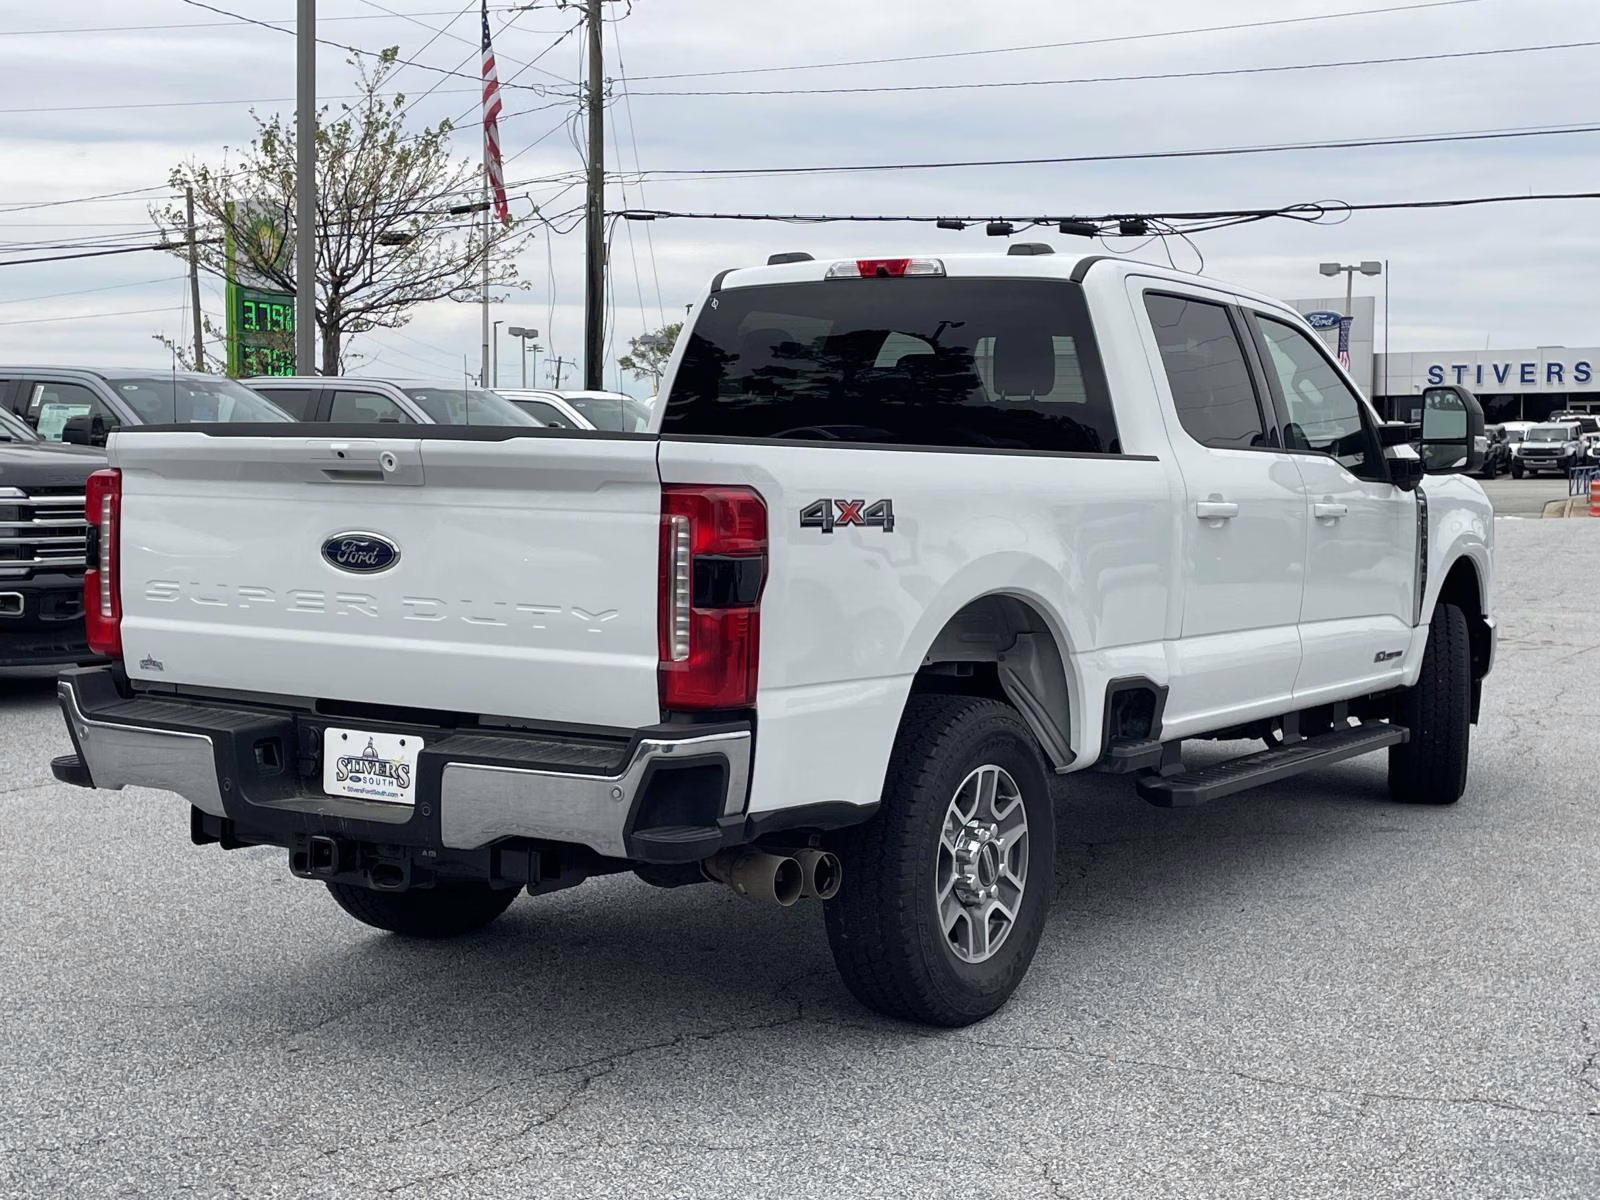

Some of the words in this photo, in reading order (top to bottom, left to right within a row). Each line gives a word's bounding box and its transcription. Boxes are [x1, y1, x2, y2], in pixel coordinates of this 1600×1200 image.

[243, 301, 284, 332] 3.79
[1310, 314, 1335, 326] Ford
[1427, 361, 1592, 386] STIVERS
[337, 539, 379, 564] Ford
[145, 579, 378, 618] SUPER
[402, 596, 618, 632] DUTY
[336, 757, 410, 789] STIVERS
[362, 776, 394, 787] SOUTH
